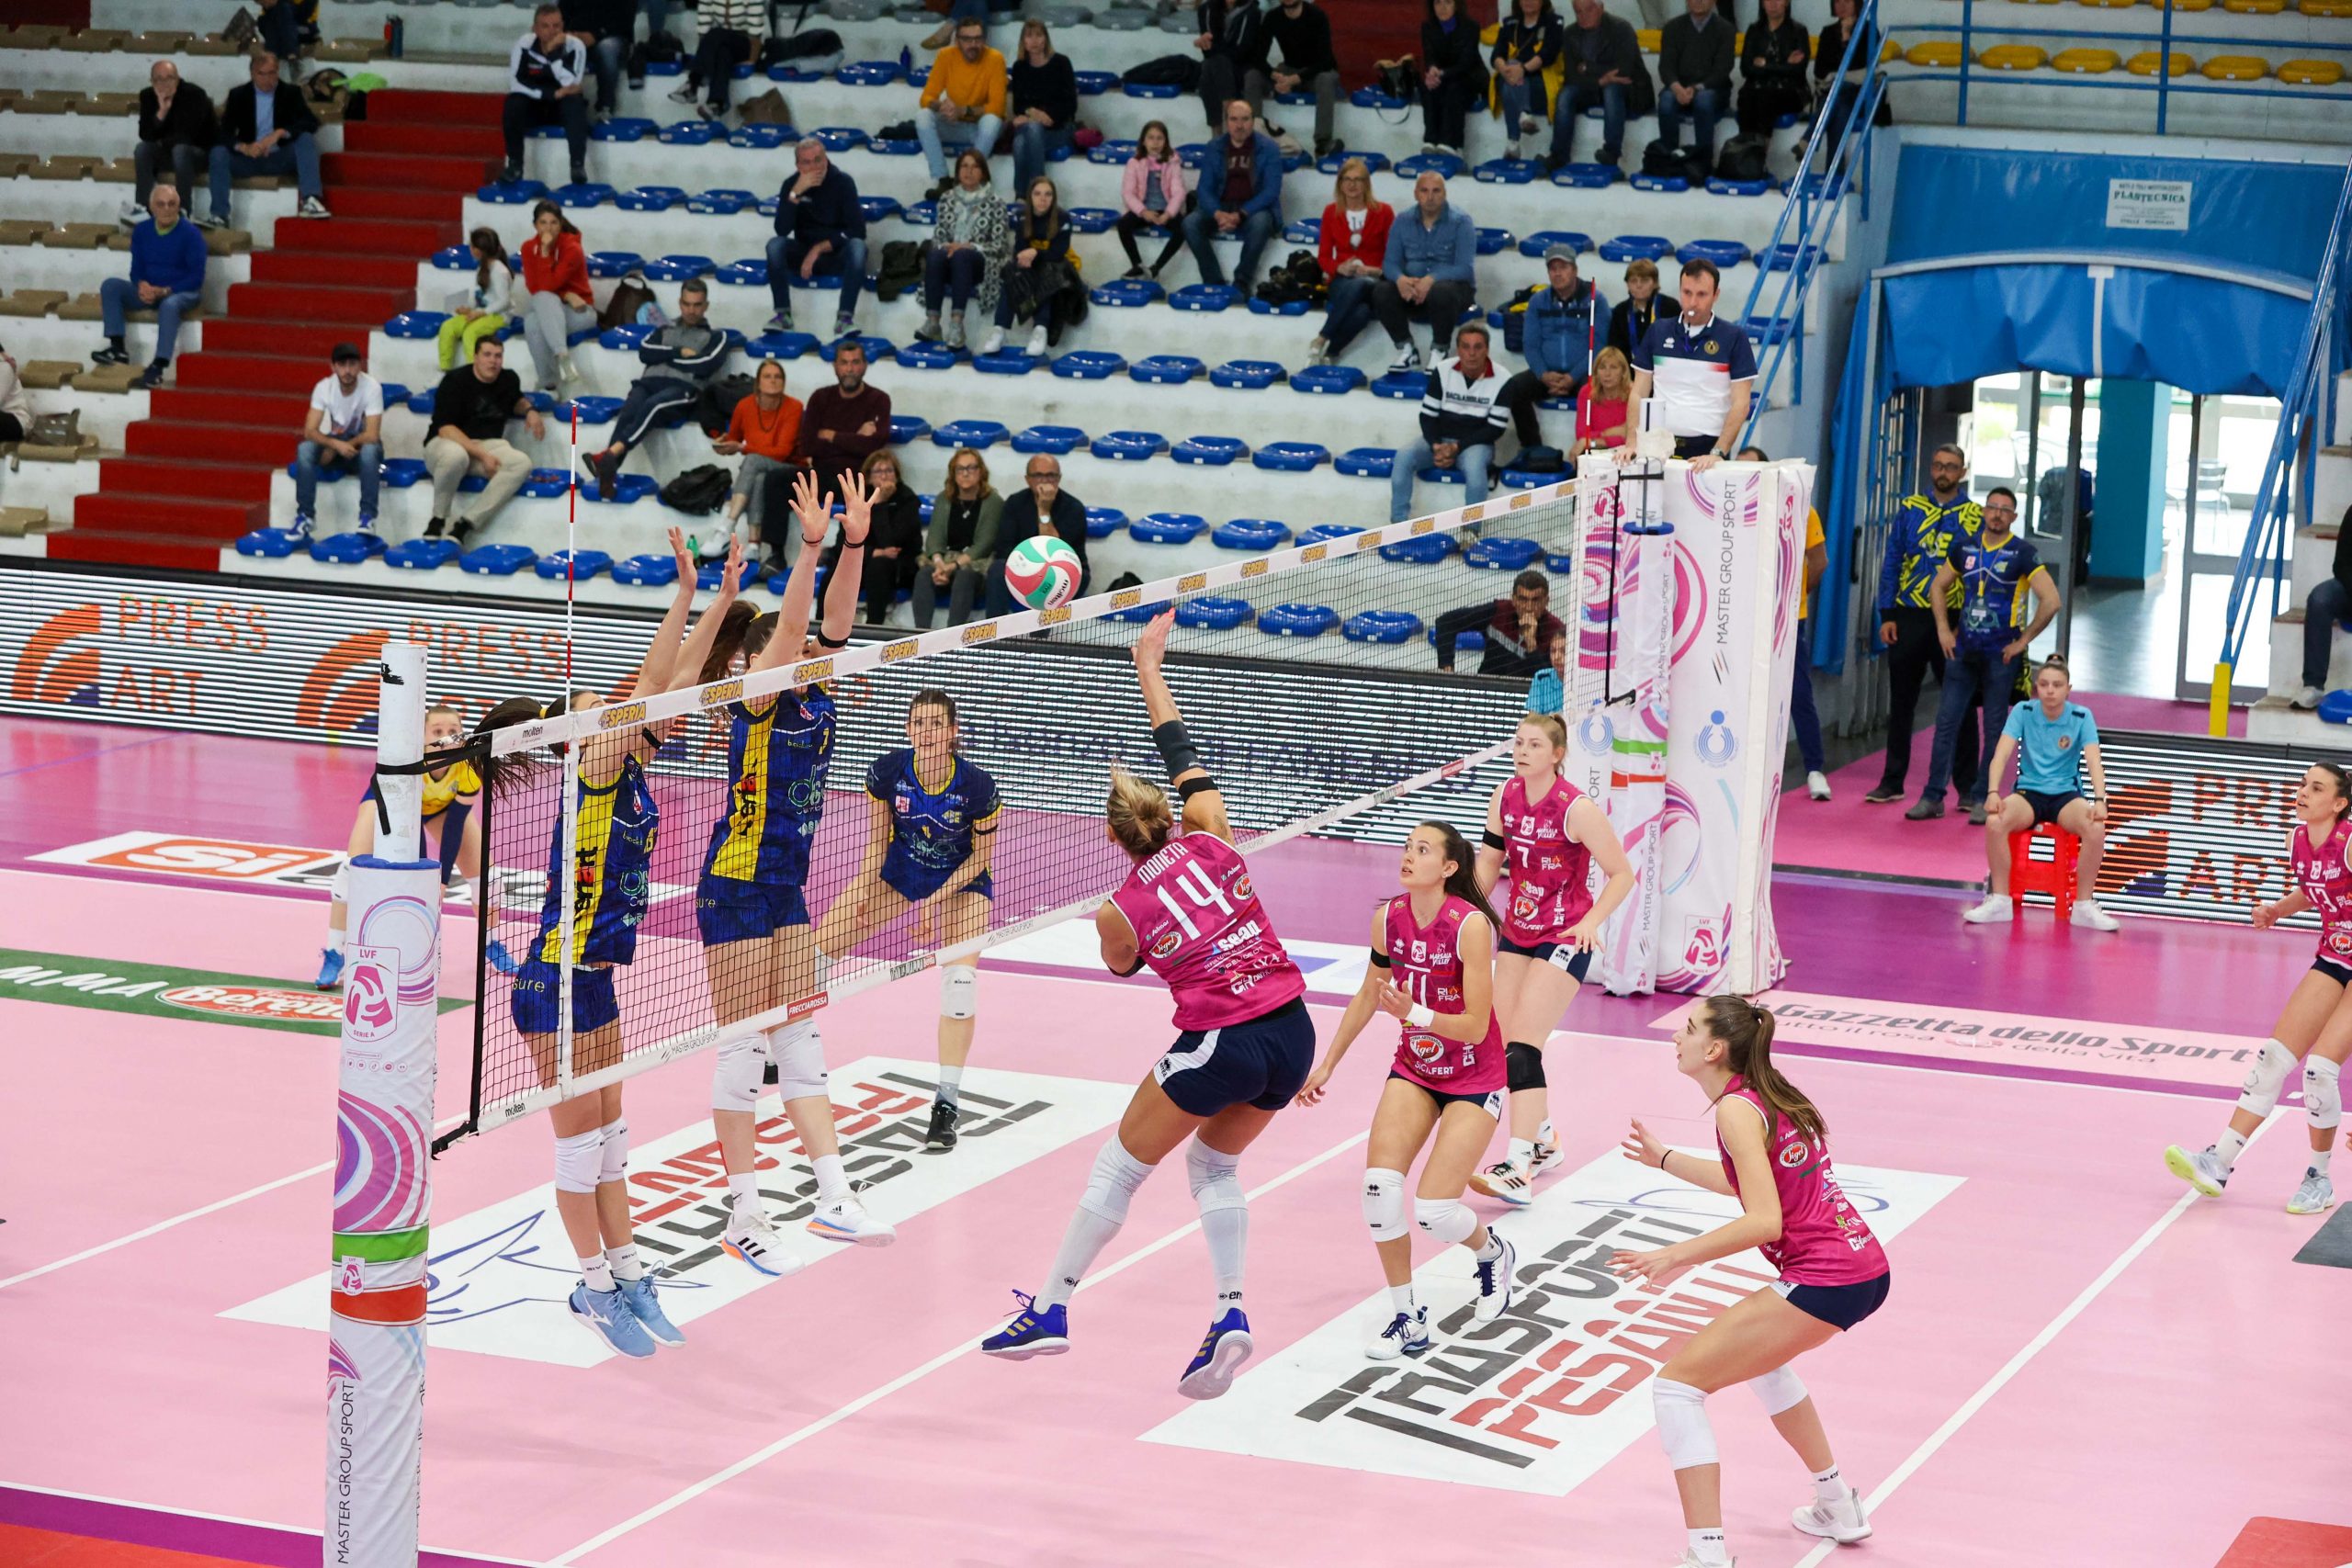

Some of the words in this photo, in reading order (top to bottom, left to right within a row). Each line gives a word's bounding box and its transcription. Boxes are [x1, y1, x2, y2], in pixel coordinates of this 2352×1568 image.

[2114, 191, 2186, 203] PLASTECNICA
[1722, 480, 1737, 528] SPORT
[1303, 544, 1328, 563] ESPERIA
[1720, 530, 1735, 585] GROUP
[1242, 558, 1269, 578] ESPERIA
[1047, 579, 1069, 605] molten
[1179, 573, 1206, 593] ESPERIA
[1112, 588, 1142, 609] ESPERIA
[119, 593, 268, 653] PRESS
[1042, 604, 1071, 625] ESPERIA
[1717, 588, 1731, 645] MASTER
[964, 622, 997, 642] ESPERIA
[409, 617, 562, 679] PRESS
[884, 638, 918, 662] ESPERIA
[797, 659, 833, 683] ESPERIA
[110, 666, 203, 715] ART
[706, 680, 744, 705] ESPERIA
[605, 702, 647, 728] ESPERIA
[522, 726, 544, 739] molten
[1649, 824, 1658, 856] SPORT
[1136, 841, 1190, 885] MONETA
[1517, 845, 1529, 868] 7
[1646, 857, 1655, 894] GROUP
[1157, 858, 1235, 941] 14
[1643, 894, 1652, 931] MASTER
[359, 949, 377, 960] LVF
[1155, 933, 1175, 955] Sigel
[1430, 952, 1453, 961] MARSALA
[1431, 957, 1452, 966] VOLLEY
[1438, 987, 1448, 997] RI
[1438, 994, 1461, 1002] FRA
[788, 995, 829, 1016] FRECCIAROSSA
[353, 1029, 368, 1038] SERIE
[672, 1041, 691, 1056] MASTER
[706, 1030, 720, 1045] SPORT
[1774, 1003, 1984, 1036] Gazzetta
[1989, 1026, 2108, 1048] dello
[2110, 1036, 2255, 1063] Sport
[1869, 1031, 1936, 1042] rosa
[2011, 1043, 2087, 1056] della
[2098, 1052, 2157, 1064] vita
[1415, 1061, 1454, 1075] SICILFERT
[504, 1102, 526, 1118] molten
[1788, 1146, 1804, 1163] Sigel
[341, 1381, 355, 1435] SPORT
[339, 1437, 353, 1497] GROUP
[337, 1500, 351, 1565] MASTER
